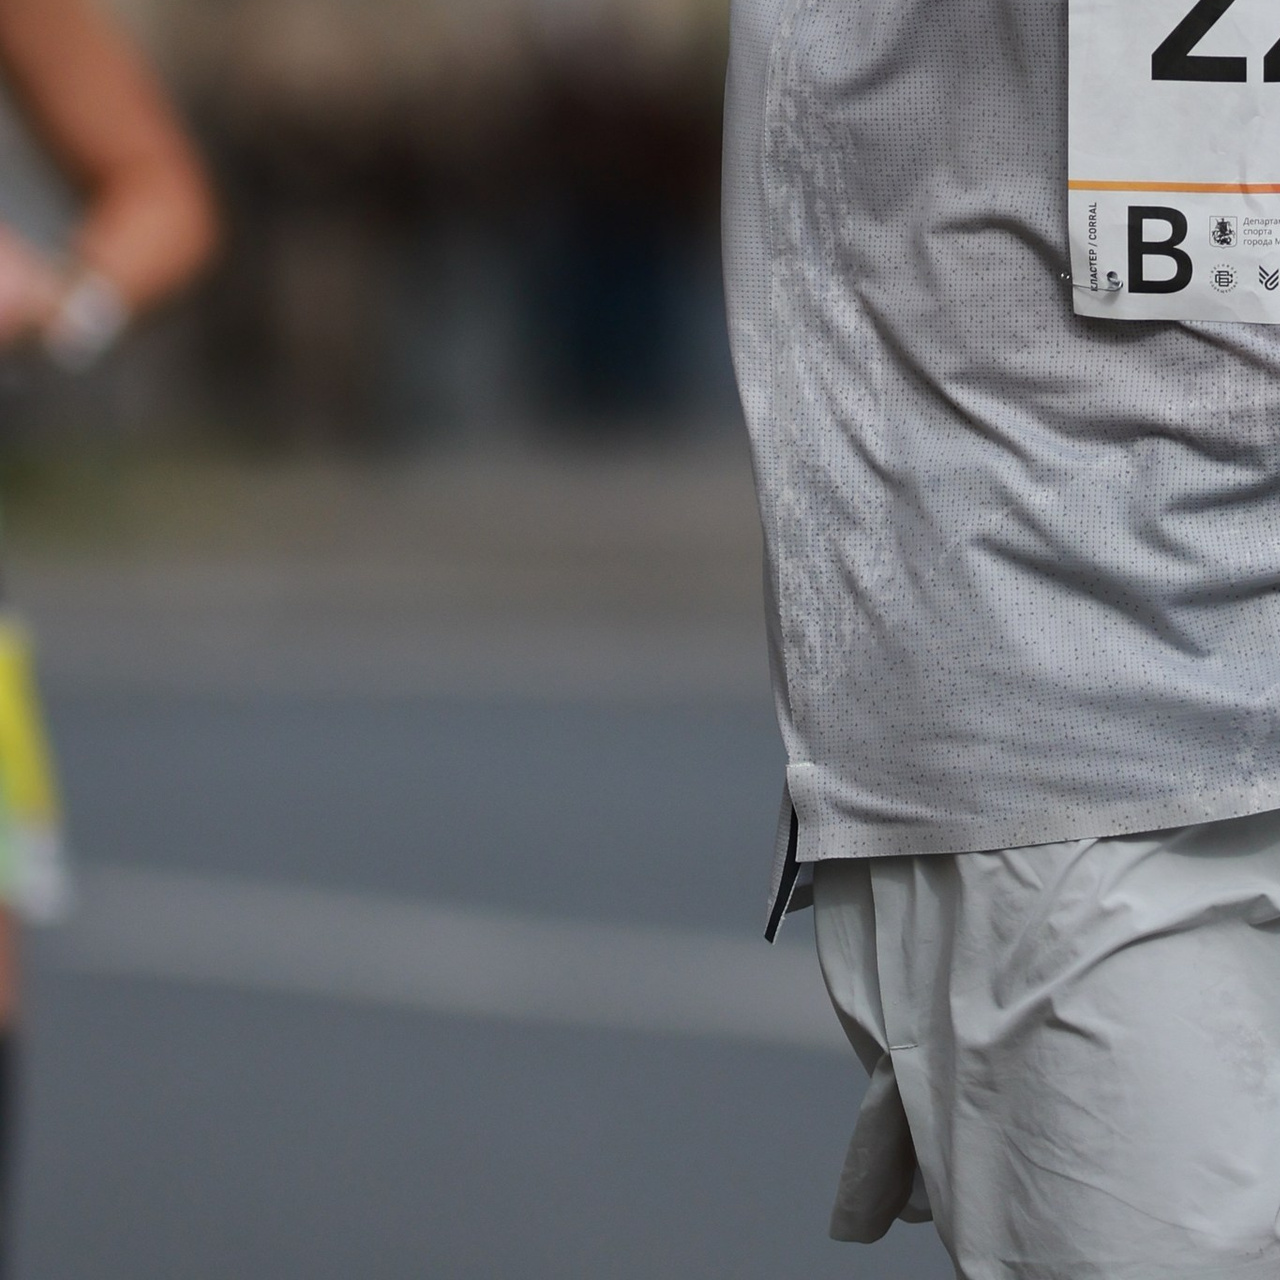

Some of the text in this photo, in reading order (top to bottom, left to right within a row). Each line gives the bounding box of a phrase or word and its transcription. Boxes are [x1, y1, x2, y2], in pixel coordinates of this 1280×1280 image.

[1088, 202, 1098, 241] CORRAL
[1243, 228, 1273, 237] спорта
[1243, 239, 1273, 247] города
